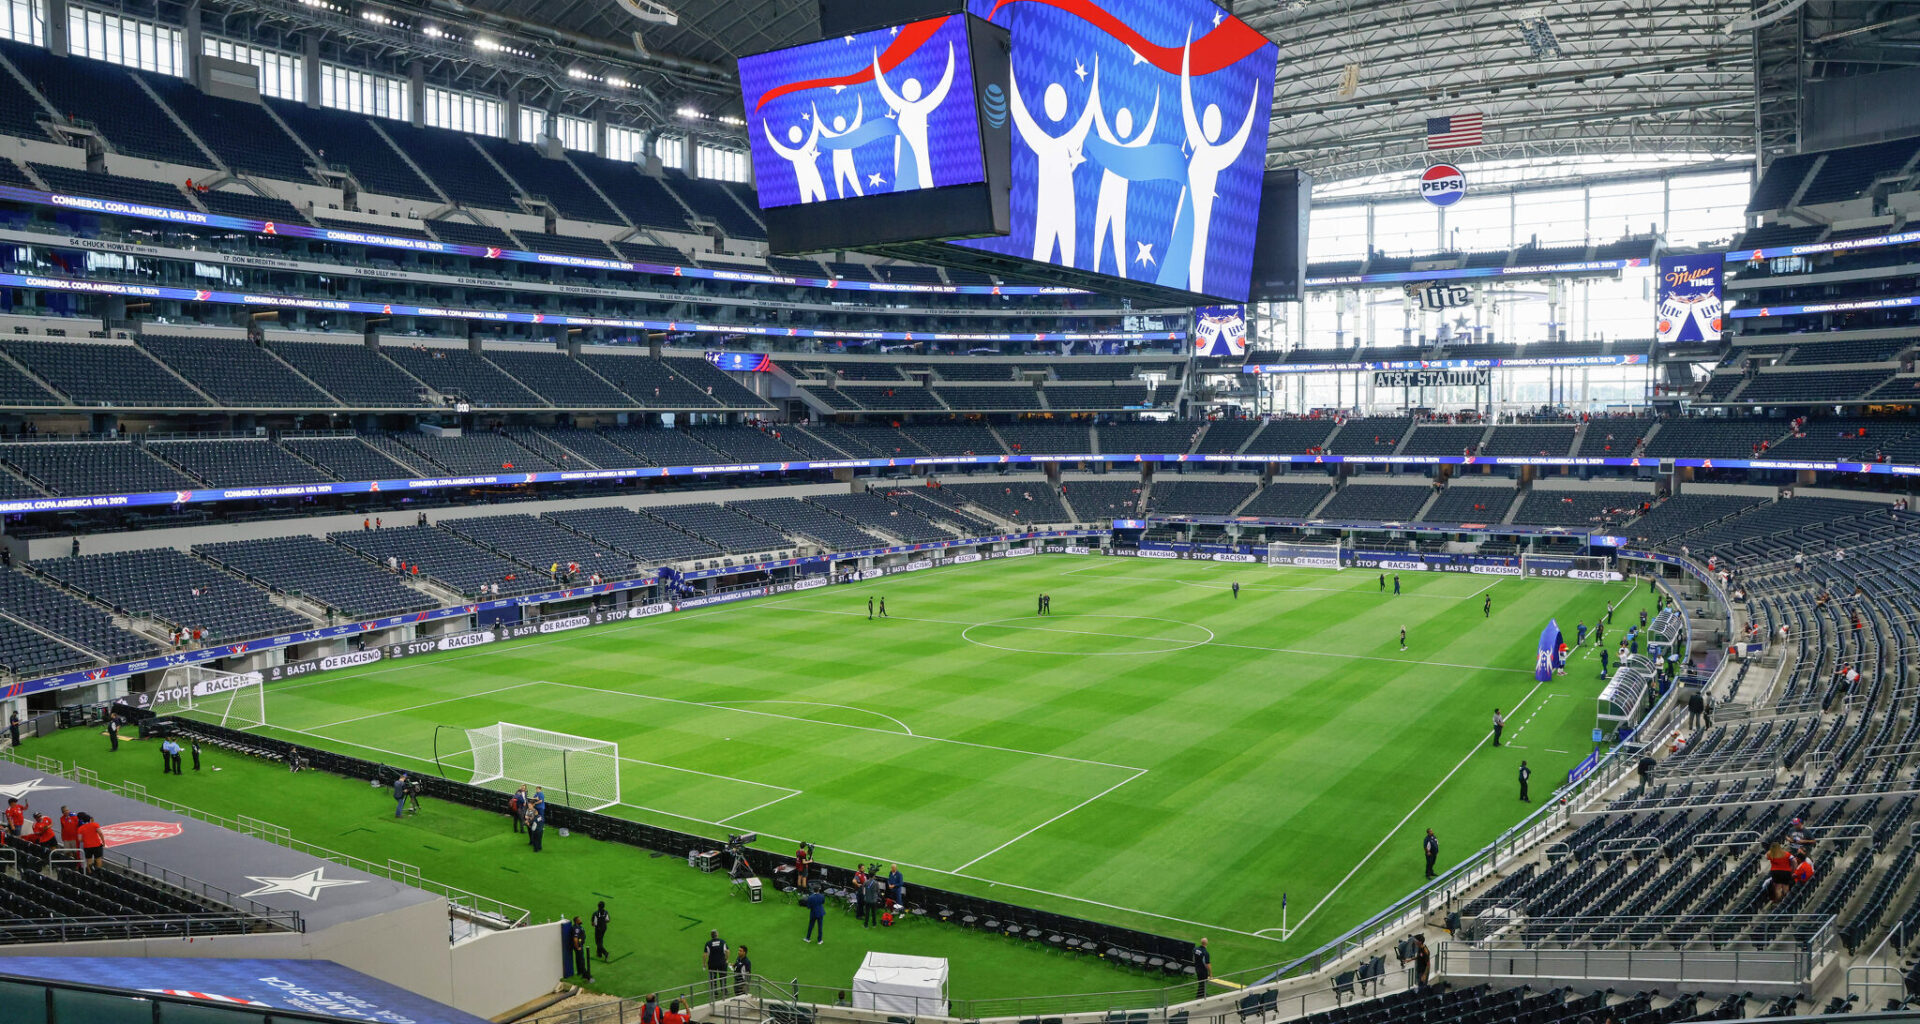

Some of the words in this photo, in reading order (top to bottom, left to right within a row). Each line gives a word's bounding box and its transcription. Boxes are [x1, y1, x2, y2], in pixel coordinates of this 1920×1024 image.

[1422, 179, 1463, 192] PEPSI
[51, 196, 103, 209] CONMEBOL
[104, 203, 130, 213] COPA
[130, 207, 168, 218] AMERICA
[169, 211, 186, 220] USA
[187, 214, 207, 222] 2024
[82, 240, 105, 248] CHUCK
[106, 243, 134, 252] HOWLEY
[327, 232, 366, 242] CONMEBOL
[384, 238, 413, 247] AMERICA
[1792, 244, 1832, 253] CONMEBOL
[1850, 238, 1888, 247] AMERICA
[1503, 266, 1539, 274] CONMEBOL
[1556, 263, 1586, 271] AMERICA
[1665, 267, 1715, 287] Miller
[1690, 278, 1715, 287] TIME
[25, 278, 71, 288] CONMEBOL
[72, 282, 92, 290] COPA
[93, 284, 126, 292] AMERICA
[1417, 286, 1468, 312] Lite
[1502, 358, 1537, 366] CONMEBOL
[1375, 372, 1413, 387] AT&T
[1417, 370, 1490, 387] STADIUM
[35, 501, 56, 509] COPA
[56, 499, 92, 507] AMERICA
[958, 554, 976, 562] RACISM
[1220, 554, 1247, 562] RACISM
[1307, 558, 1336, 566] RACISMO
[1387, 561, 1418, 569] RACISM
[1485, 566, 1520, 574] RACISMO
[1541, 569, 1566, 577] STOP
[1577, 571, 1611, 580] RACISM
[776, 584, 793, 593] BASTA
[804, 578, 826, 589] RACISMO
[606, 610, 627, 621] STOP
[636, 603, 664, 616] RACISM
[513, 625, 538, 636] BASTA
[544, 622, 554, 632] DE
[555, 617, 588, 631] RACISMO
[408, 641, 435, 655] STOP
[448, 632, 484, 648] RACISM
[286, 661, 317, 677] BASTA
[325, 656, 339, 669] DE
[339, 649, 379, 665] RACISMO
[157, 685, 189, 703] STOP
[258, 976, 368, 1016] AMERICA
